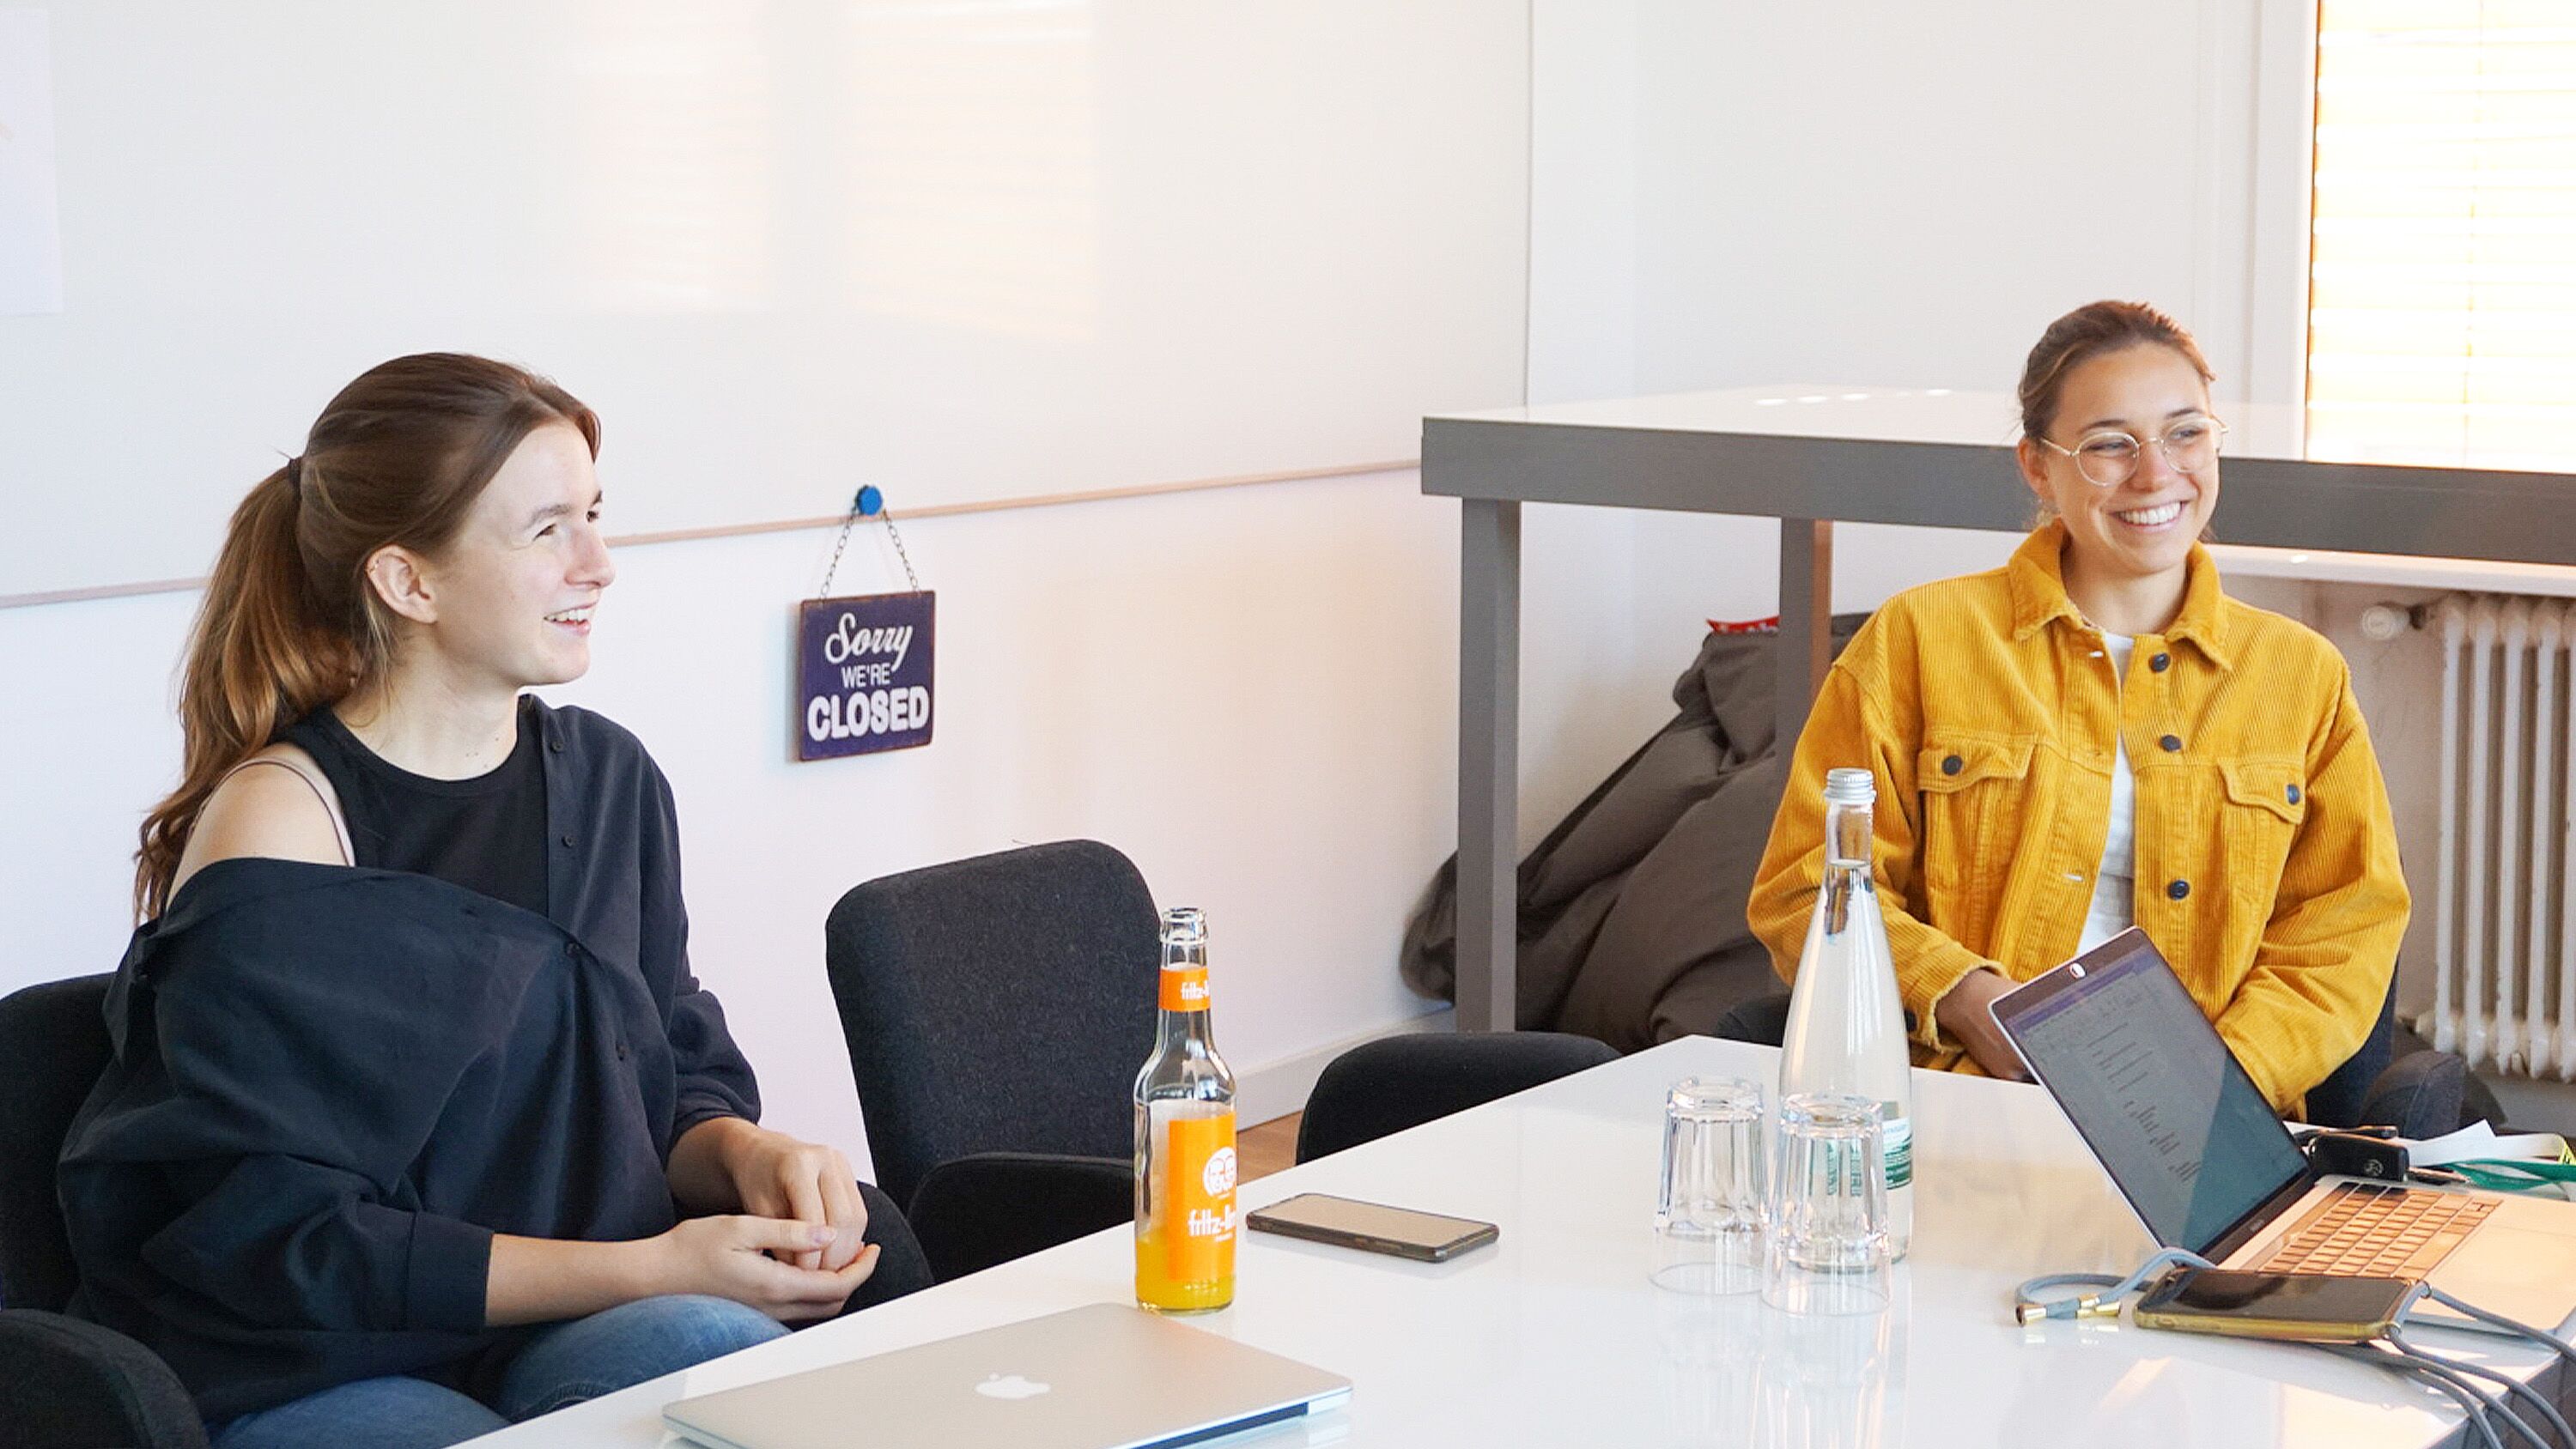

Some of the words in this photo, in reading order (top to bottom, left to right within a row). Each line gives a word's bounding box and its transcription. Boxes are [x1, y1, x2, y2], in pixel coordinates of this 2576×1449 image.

[825, 612, 913, 673] Sorry
[841, 663, 891, 688] WE'RE
[807, 686, 929, 742] CLOSED
